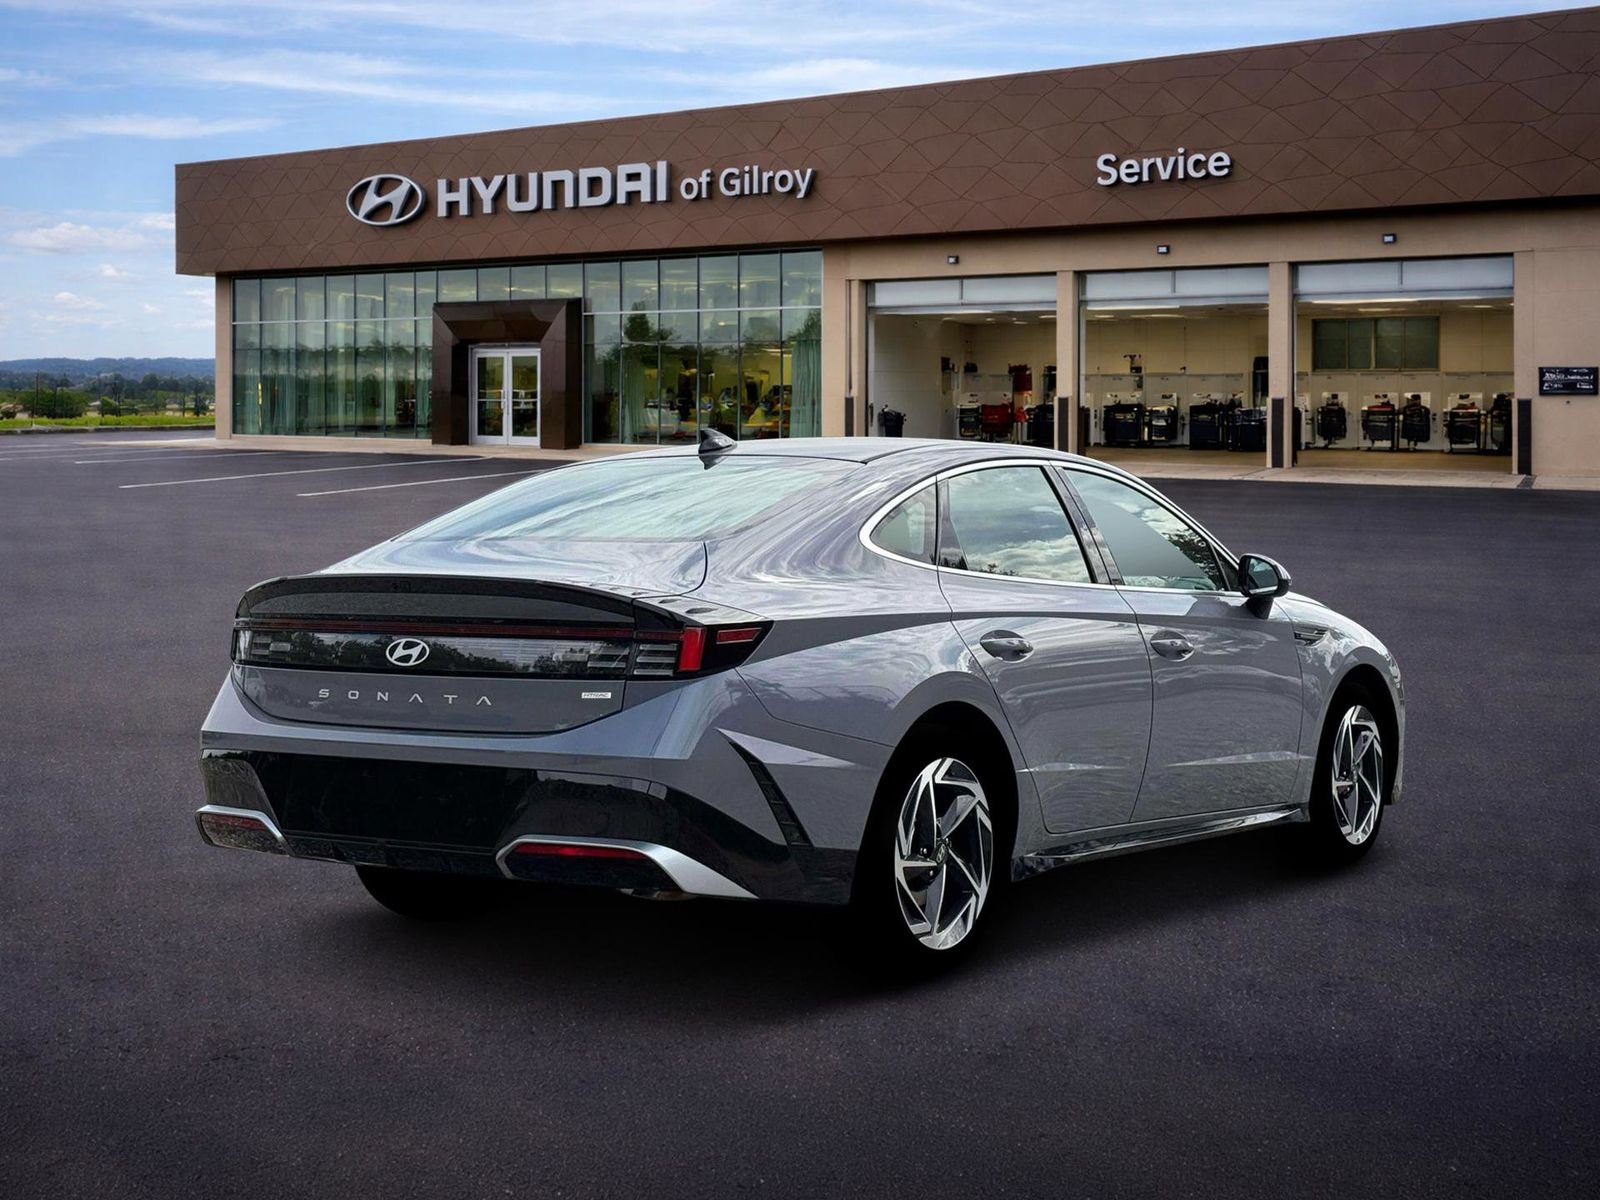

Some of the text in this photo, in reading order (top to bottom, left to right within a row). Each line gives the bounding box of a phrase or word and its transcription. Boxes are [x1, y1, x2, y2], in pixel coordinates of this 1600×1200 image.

[1096, 147, 1231, 186] Service
[437, 160, 815, 218] HYUNDAI of Gilroy
[318, 688, 492, 706] SONATA
